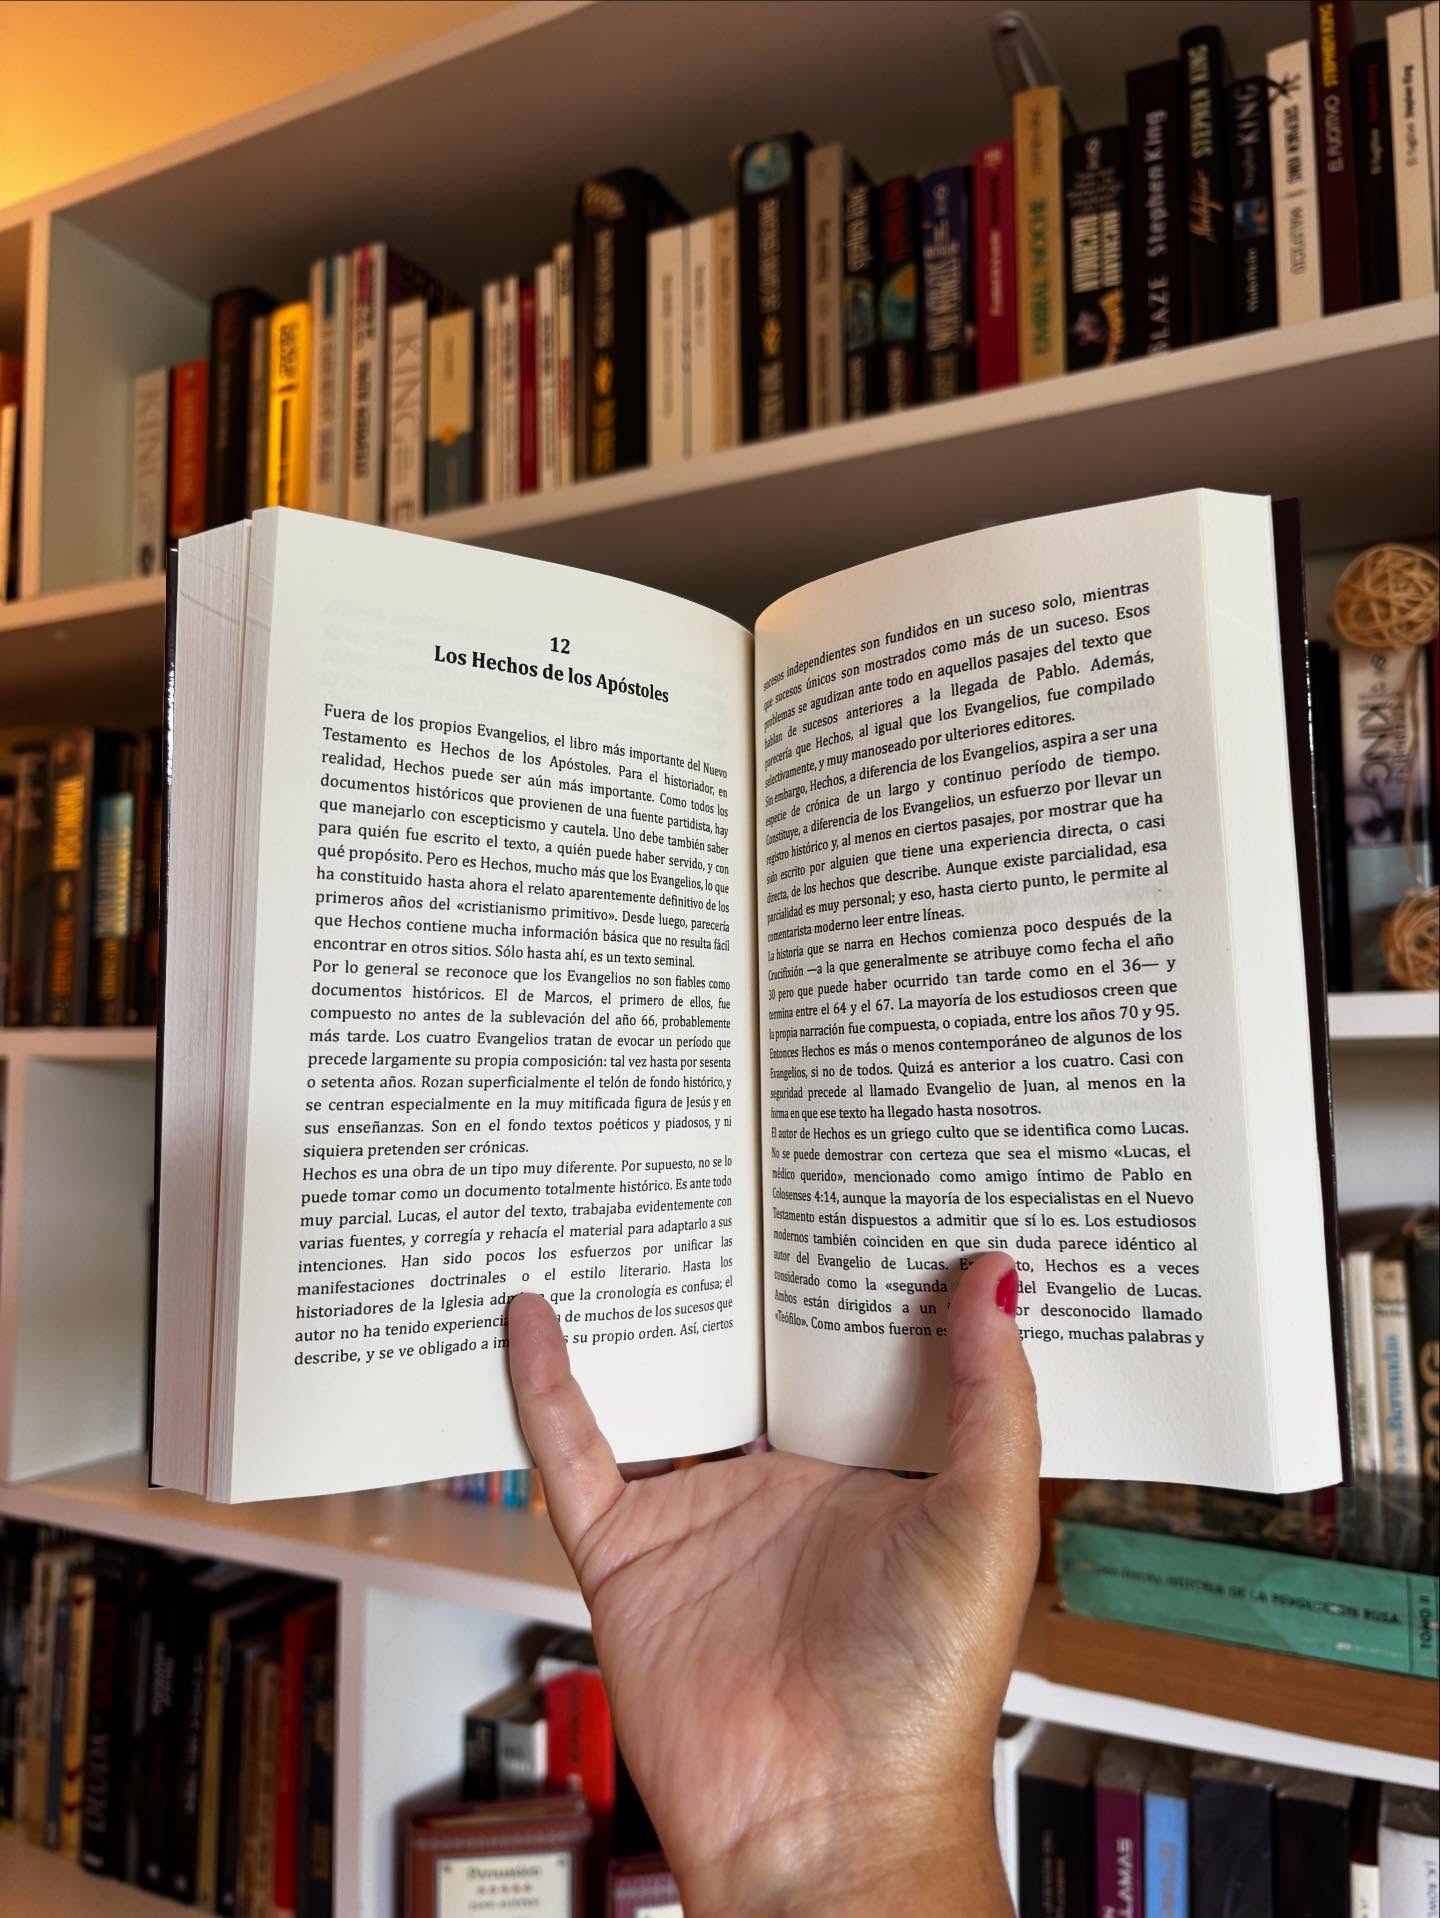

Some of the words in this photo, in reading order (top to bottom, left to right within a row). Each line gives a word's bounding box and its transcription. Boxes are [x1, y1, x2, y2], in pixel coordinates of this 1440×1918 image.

[1187, 43, 1211, 98] KING
[1401, 64, 1414, 84] King
[1232, 82, 1263, 146] KING
[1322, 94, 1344, 155] FUGITIVO
[1403, 86, 1415, 120] Stephen
[1144, 109, 1169, 162] King
[1188, 100, 1212, 160] STEPHEN
[1326, 155, 1345, 174] EL
[1144, 164, 1170, 258] Stephen
[550, 636, 570, 654] 12
[763, 671, 784, 691] sucesos
[786, 644, 856, 677] independientes
[860, 638, 880, 652] son
[885, 622, 938, 645] fundidos
[943, 618, 959, 630] en
[965, 613, 983, 625] un
[988, 602, 1035, 620] suceso
[1042, 593, 1075, 610] solo,
[1082, 581, 1149, 602] mientras
[433, 644, 466, 665] Los
[471, 650, 538, 677] Hechos
[542, 663, 564, 681] de
[567, 666, 592, 686] los
[595, 673, 668, 703] Apóstoles
[322, 726, 407, 749] Testamento
[416, 741, 431, 752] es
[440, 740, 490, 759] Hechos
[498, 747, 514, 762] de
[522, 750, 541, 765] los
[548, 755, 611, 775] Apóstoles.
[618, 764, 642, 780] Para
[648, 770, 658, 783] el
[663, 772, 714, 794] historiador,
[718, 788, 727, 798] en
[324, 703, 365, 721] Fuera
[370, 708, 388, 724] de
[393, 711, 414, 727] los
[419, 719, 472, 735] propios
[477, 723, 549, 746] Evangelios,
[554, 734, 564, 747] el
[569, 735, 597, 752] libro
[602, 743, 625, 756] más
[629, 746, 684, 768] importante
[686, 757, 700, 771] del
[702, 761, 727, 778] Nuevo
[764, 761, 817, 788] selectivamente,
[818, 758, 824, 771] y
[826, 752, 848, 766] muy
[850, 736, 916, 760] manoseado
[919, 733, 942, 750] por
[944, 721, 1010, 742] ulteriores
[1013, 712, 1075, 730] editores.
[313, 938, 387, 951] encontrar
[390, 942, 407, 952] en
[411, 942, 448, 954] otros
[451, 943, 491, 956] sitios.
[495, 944, 523, 958] Sólo
[526, 945, 561, 960] hasta
[564, 948, 586, 962] ahí,
[589, 952, 603, 962] es
[605, 953, 620, 963] un
[623, 953, 651, 964] texto
[653, 955, 694, 967] seminal.
[768, 988, 775, 1000] 30
[777, 988, 794, 1002] pero
[797, 986, 813, 999] que
[817, 980, 848, 998] puede
[852, 977, 887, 991] haber
[893, 972, 948, 988] ocurrido
[955, 972, 977, 984] tan
[983, 966, 1021, 982] tarde
[1028, 966, 1068, 979] como
[1075, 964, 1094, 975] en
[1100, 959, 1114, 973] el
[1165, 958, 1176, 972] y
[307, 1051, 367, 1068] precede
[371, 1051, 451, 1068] largamente
[454, 1056, 471, 1065] su
[474, 1053, 518, 1069] propia
[522, 1054, 606, 1069] composición:
[609, 1054, 624, 1067] tal
[627, 1058, 647, 1067] vez
[649, 1054, 678, 1067] hasta
[680, 1058, 697, 1070] por
[699, 1057, 731, 1067] sesenta
[297, 1258, 386, 1273] intenciones.
[401, 1254, 428, 1267] Han
[442, 1250, 471, 1264] sido
[485, 1251, 525, 1265] pocos
[537, 1246, 557, 1259] los
[569, 1244, 631, 1258] esfuerzos
[642, 1244, 663, 1258] por
[673, 1238, 712, 1252] unificar
[720, 1235, 732, 1247] las
[773, 1227, 808, 1243] modernos
[812, 1232, 856, 1246] también
[862, 1234, 924, 1248] coinciden
[930, 1238, 947, 1248] en
[954, 1238, 980, 1251] que
[987, 1236, 1008, 1248] sin
[1015, 1235, 1051, 1249] duda
[1057, 1239, 1107, 1252] parece
[1114, 1236, 1175, 1251] idéntico
[1183, 1237, 1197, 1251] al
[810, 1315, 840, 1331] Como
[843, 1319, 884, 1334] ambos
[888, 1321, 932, 1336] fueron
[1067, 1326, 1124, 1341] muchas
[1126, 1328, 1192, 1344] palabras
[1194, 1334, 1204, 1348] y
